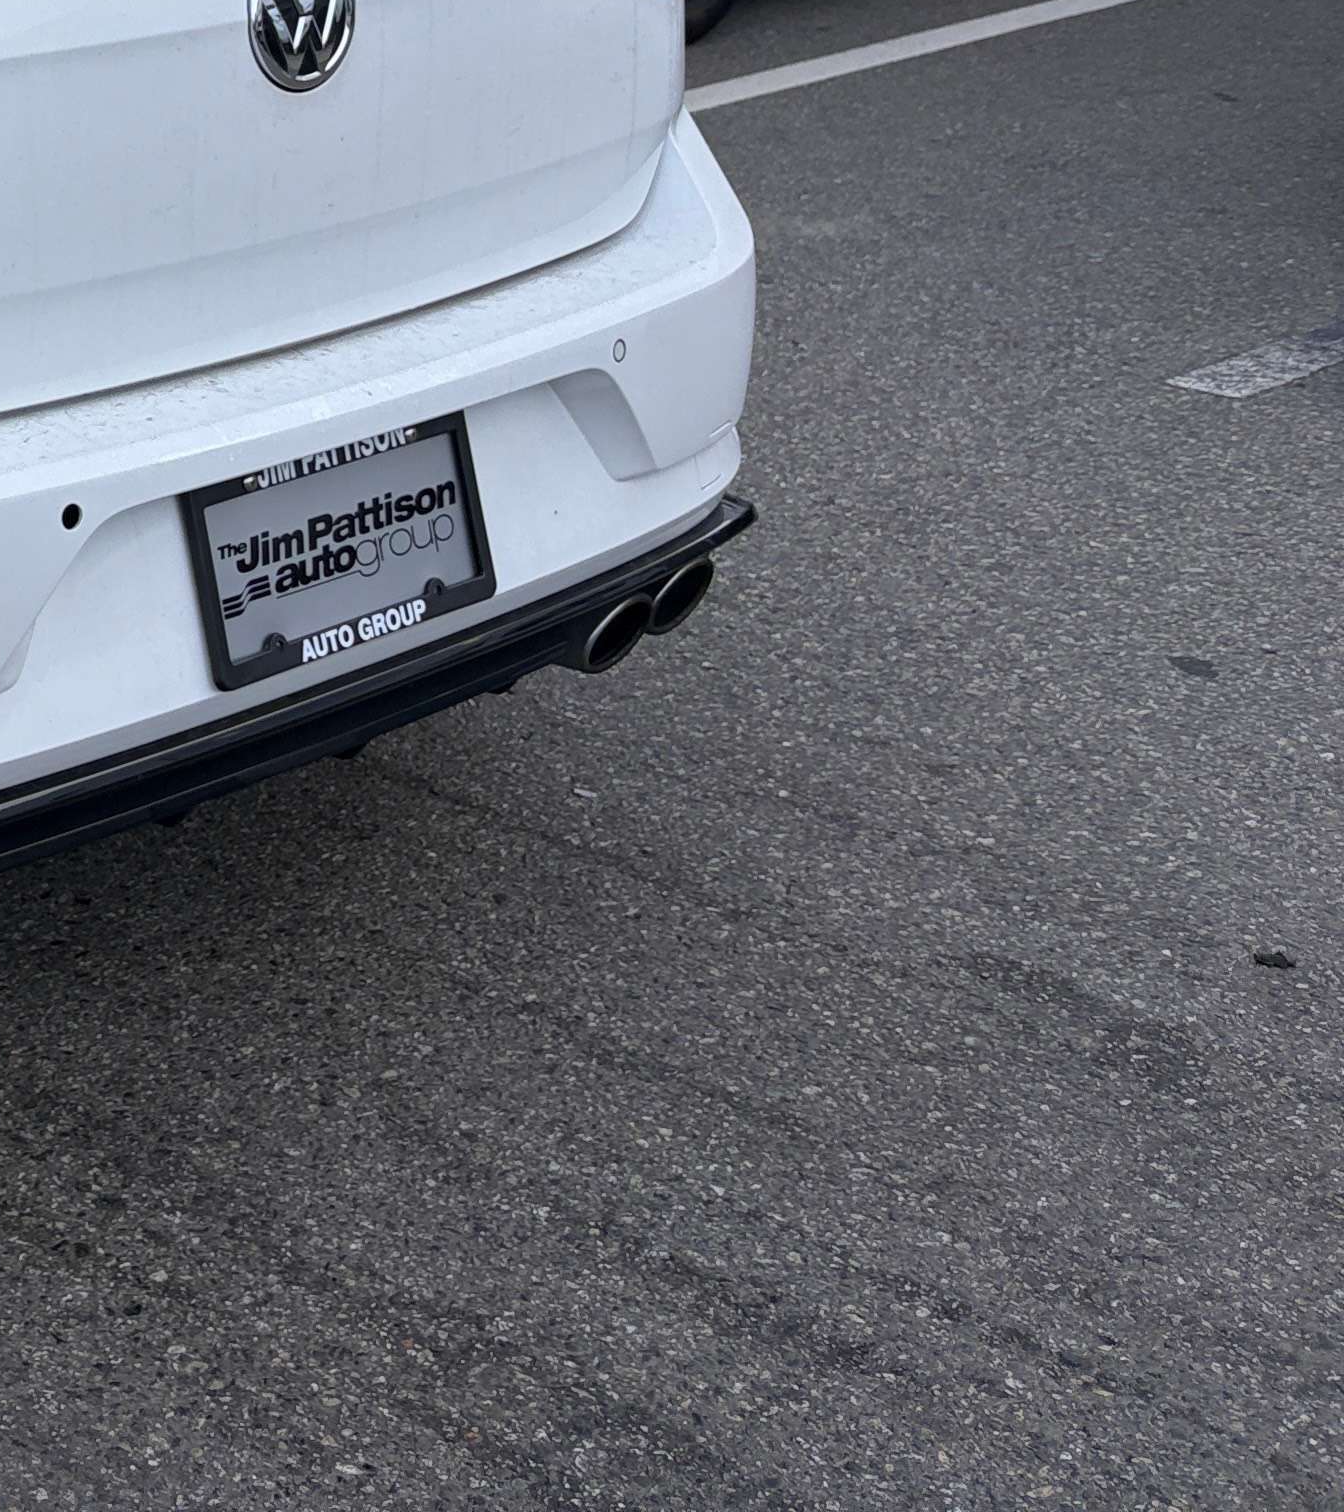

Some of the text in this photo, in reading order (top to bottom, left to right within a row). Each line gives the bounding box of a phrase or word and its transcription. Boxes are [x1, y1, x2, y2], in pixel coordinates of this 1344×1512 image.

[257, 428, 407, 489] JIM PATTISON
[217, 479, 456, 574] The Jim Pattison
[301, 598, 427, 663] AUTO GROUP
